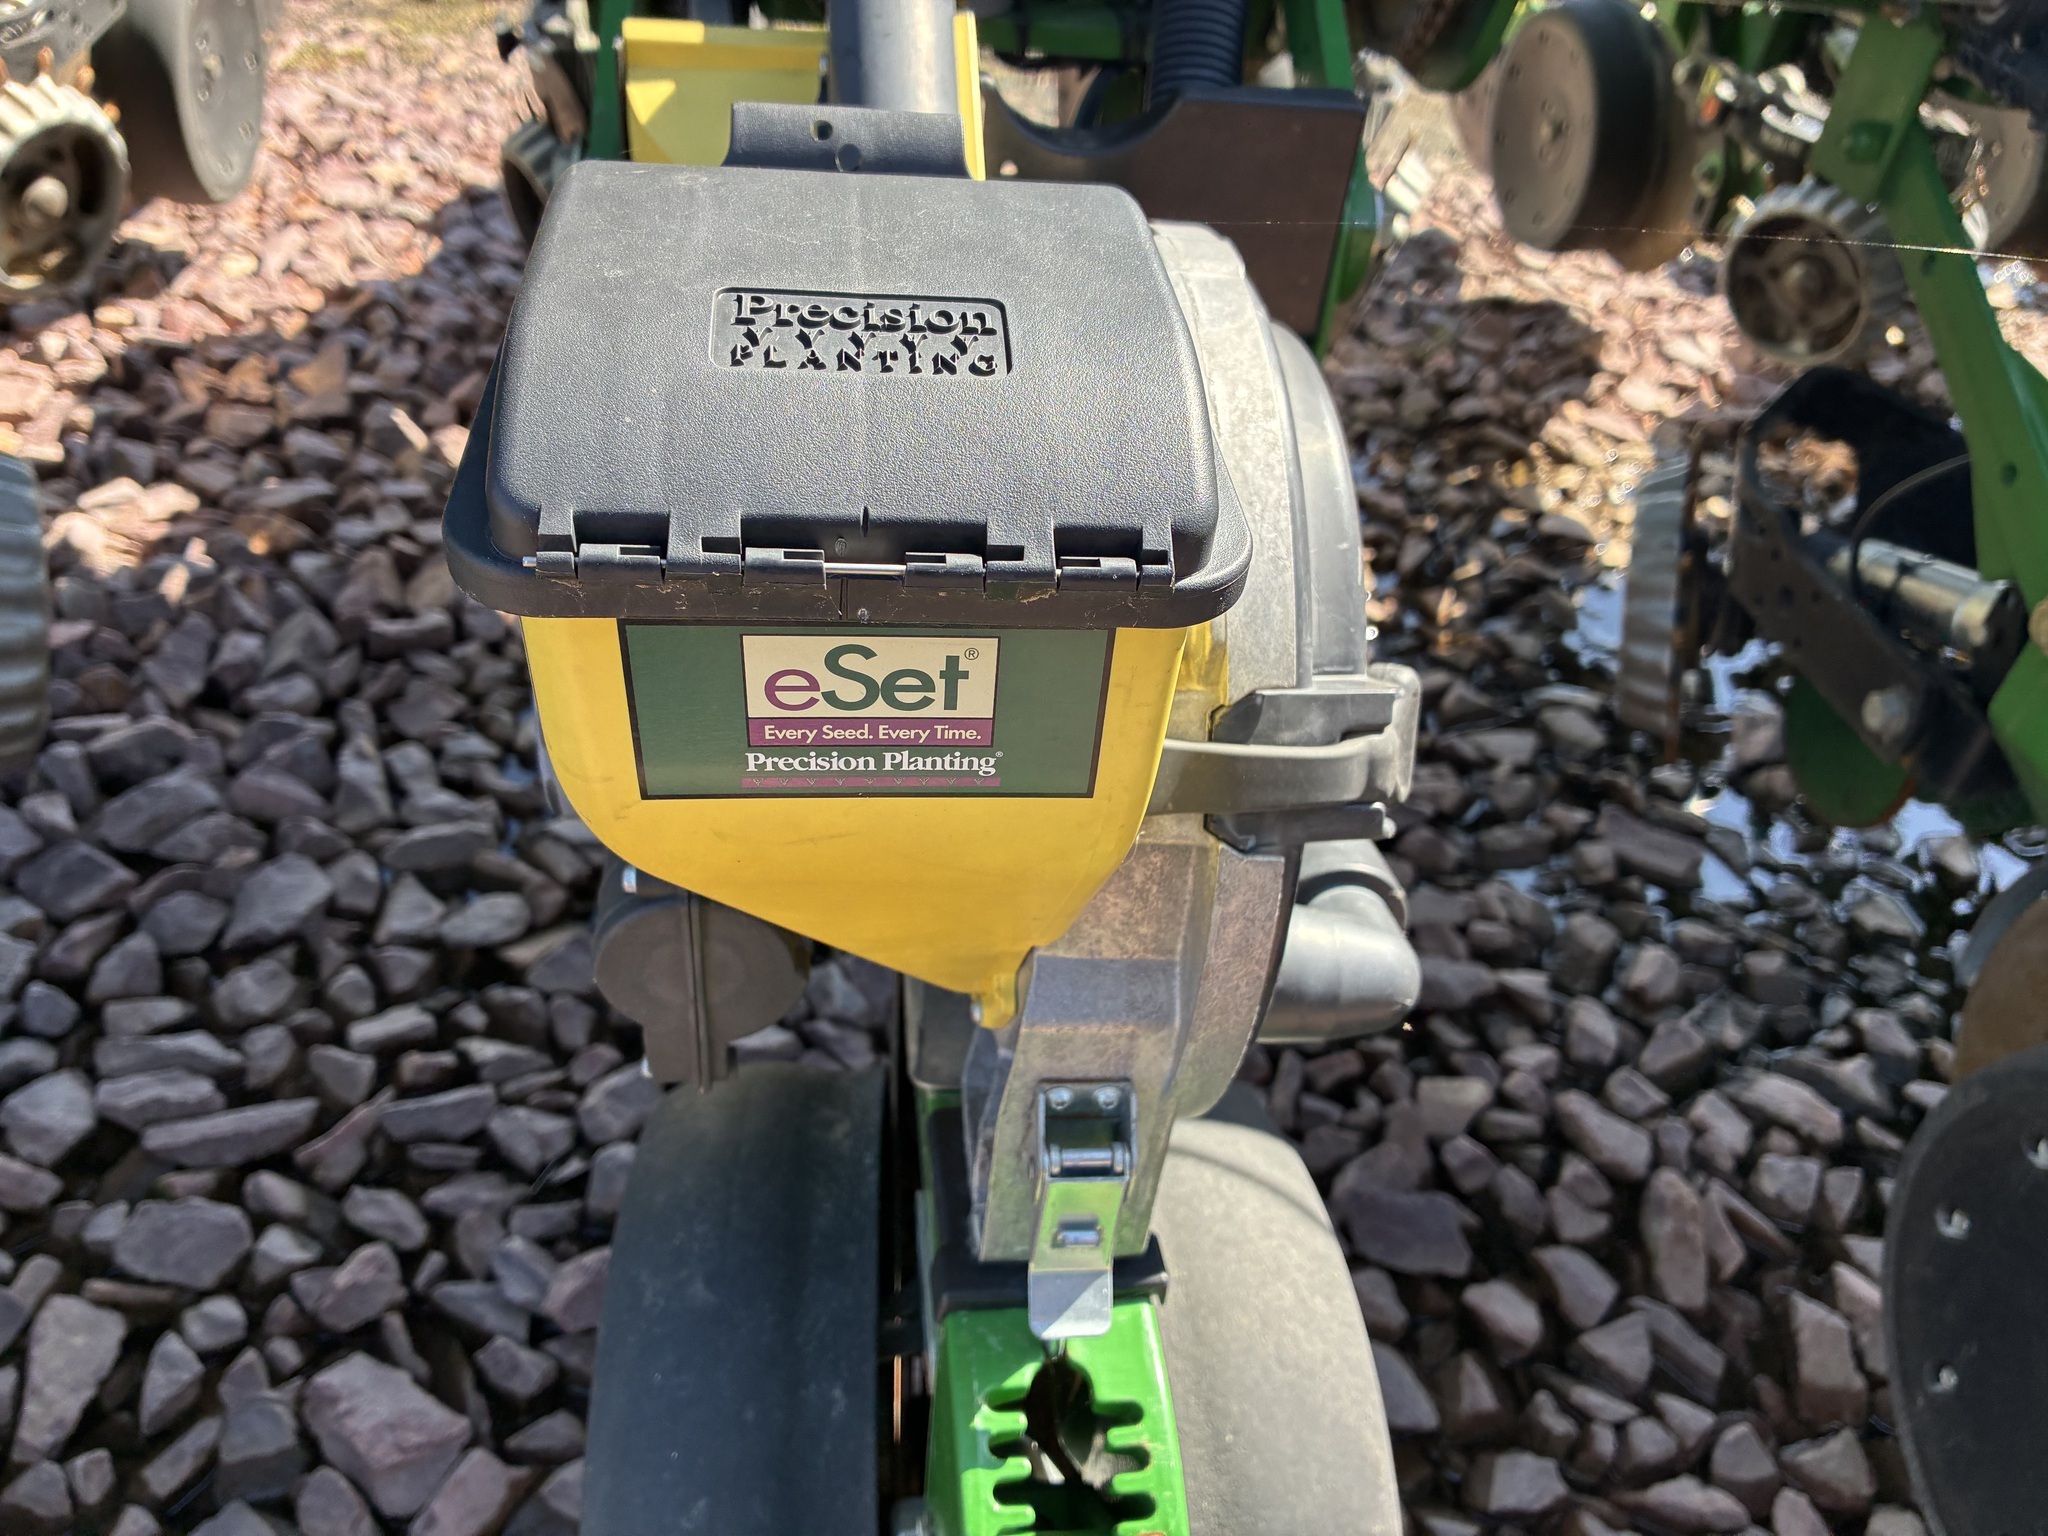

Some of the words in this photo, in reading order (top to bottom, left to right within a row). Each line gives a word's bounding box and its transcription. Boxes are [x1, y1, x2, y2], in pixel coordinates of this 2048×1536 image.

[731, 294, 997, 335] Precision
[730, 342, 998, 377] PLANTING
[764, 725, 818, 743] Every
[822, 723, 874, 740] Seed.
[878, 725, 931, 743] Every
[934, 725, 982, 740] Time.
[745, 751, 877, 772] Precision
